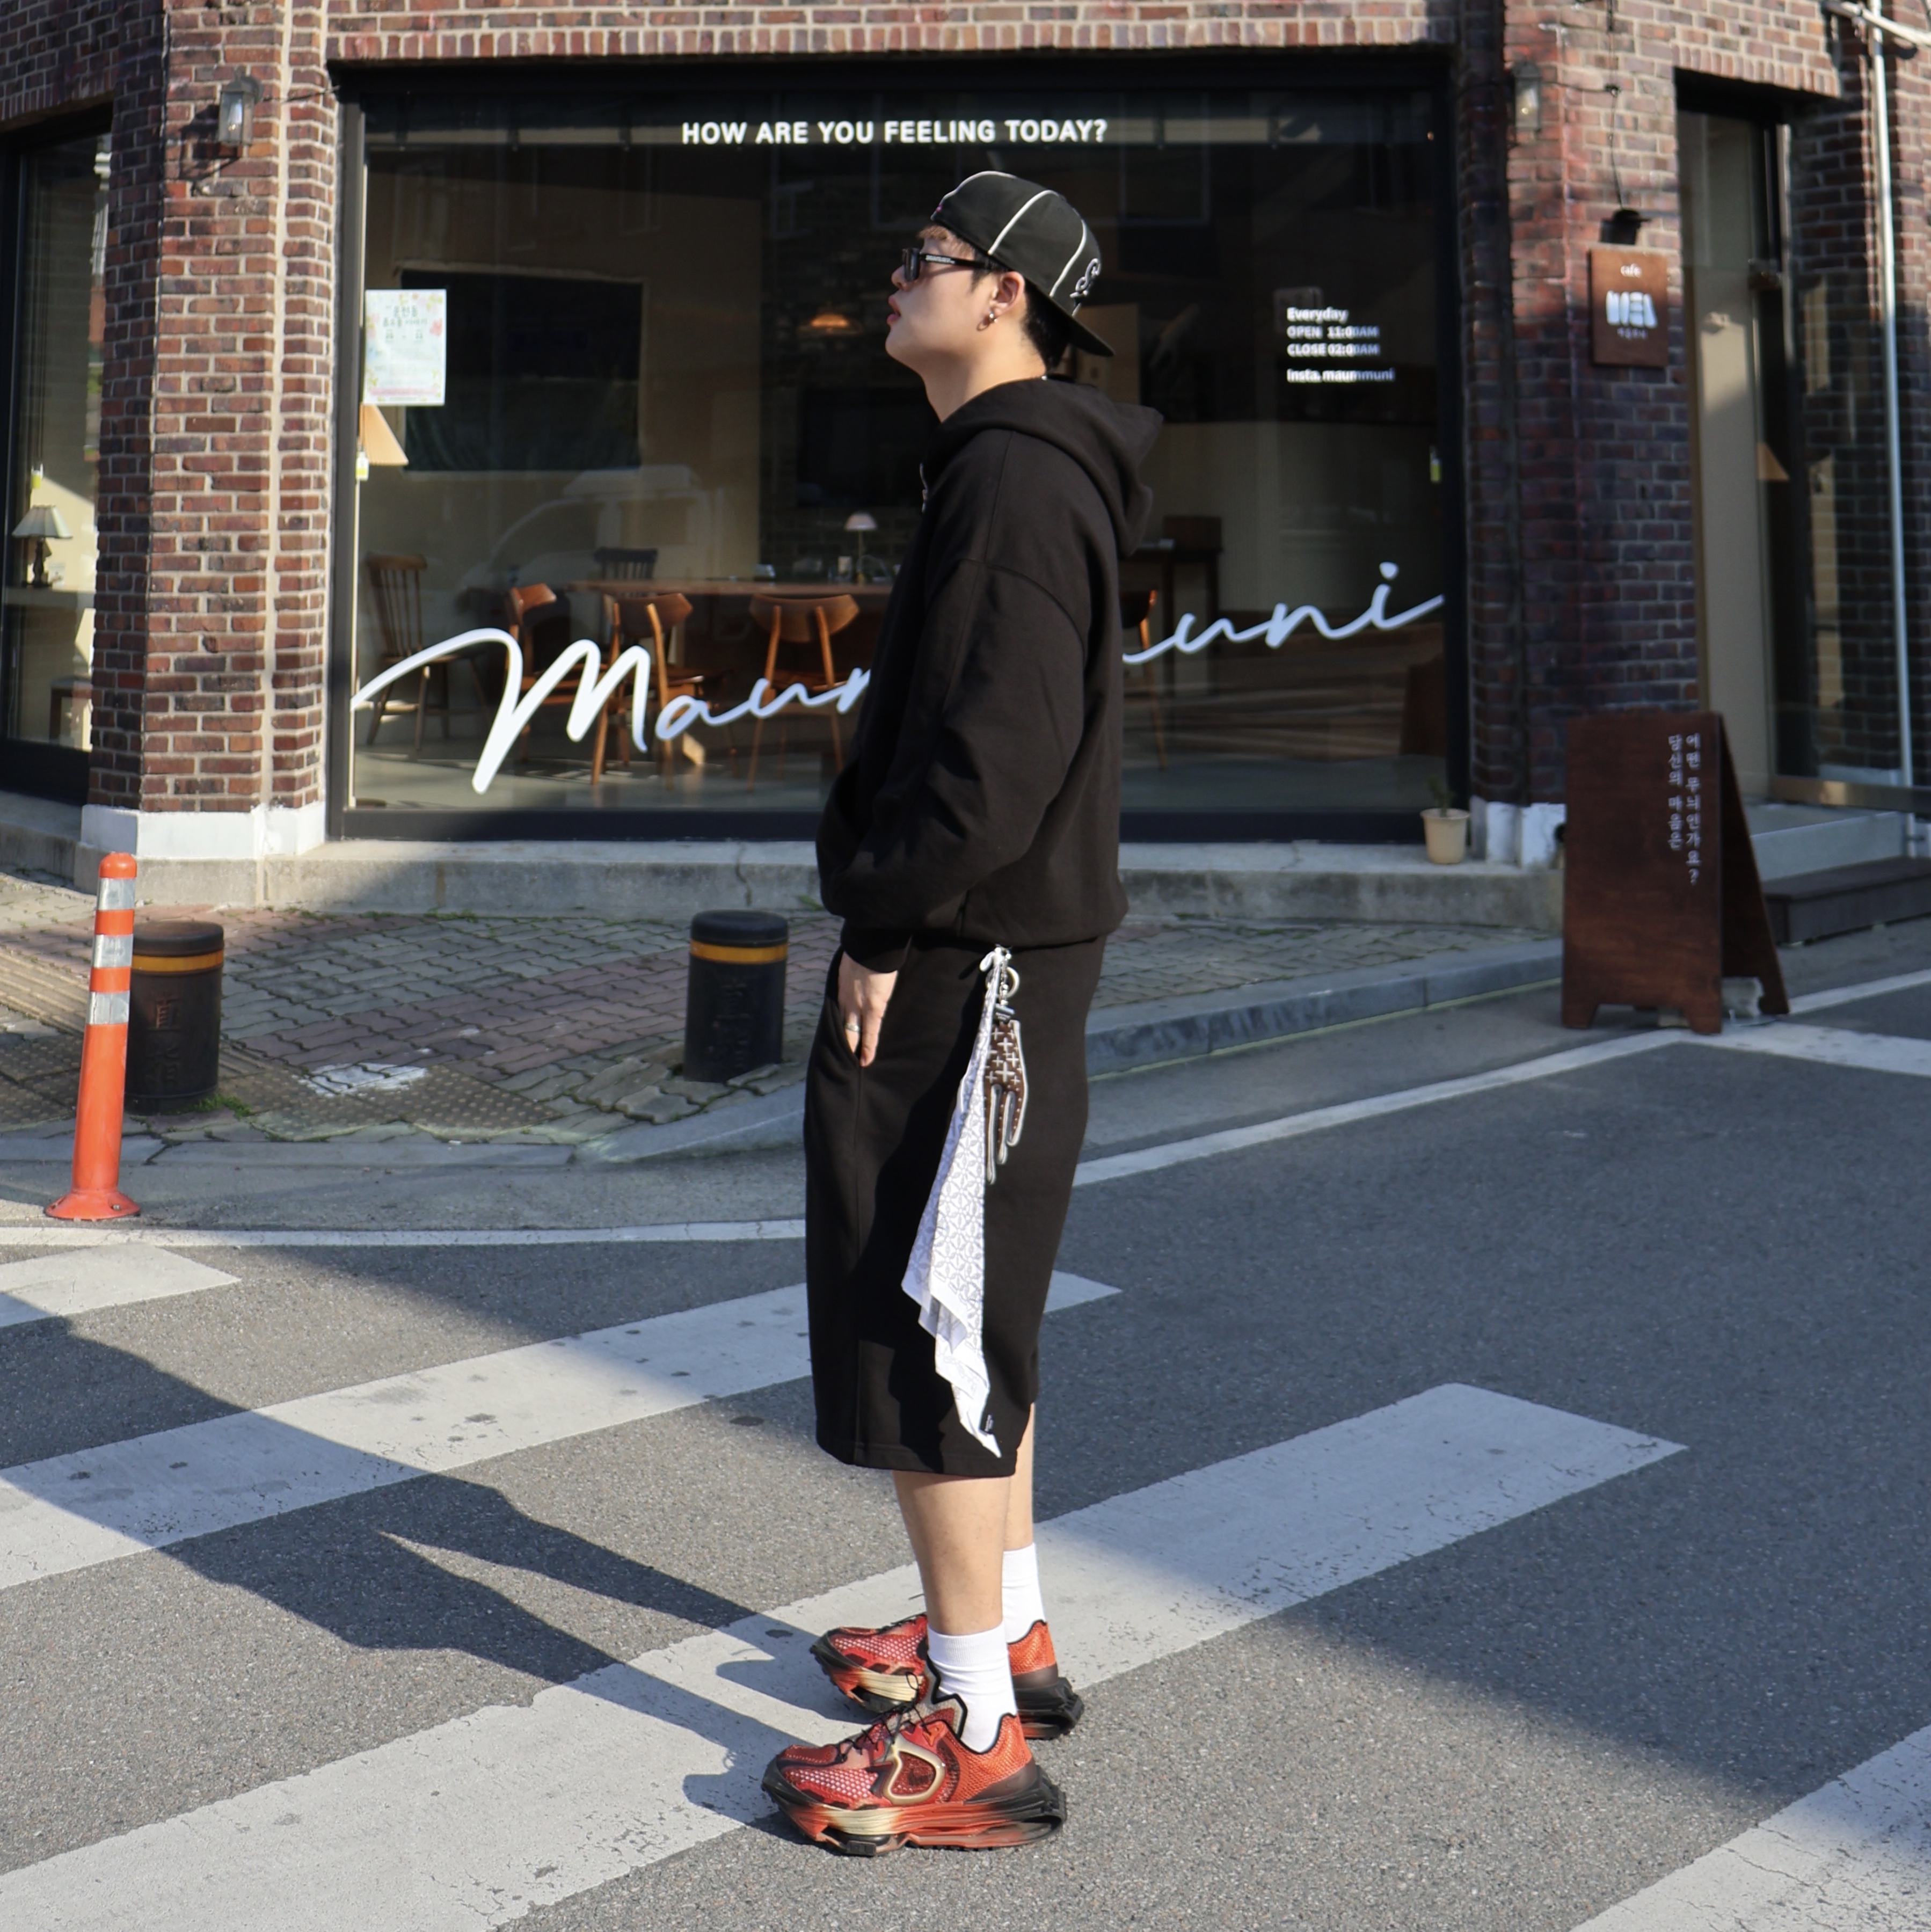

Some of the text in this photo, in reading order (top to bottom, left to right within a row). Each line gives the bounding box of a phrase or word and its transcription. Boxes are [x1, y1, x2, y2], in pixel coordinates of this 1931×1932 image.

[682, 119, 1108, 144] HOW ARE YOU FEELING TODAY?
[1286, 306, 1349, 324] Everyday
[1286, 325, 1323, 339] OPEN
[1286, 342, 1327, 358] CLOSE
[1668, 734, 1683, 850] 당신의 마음은
[1686, 733, 1701, 885] 어떤 무늬인가요?
